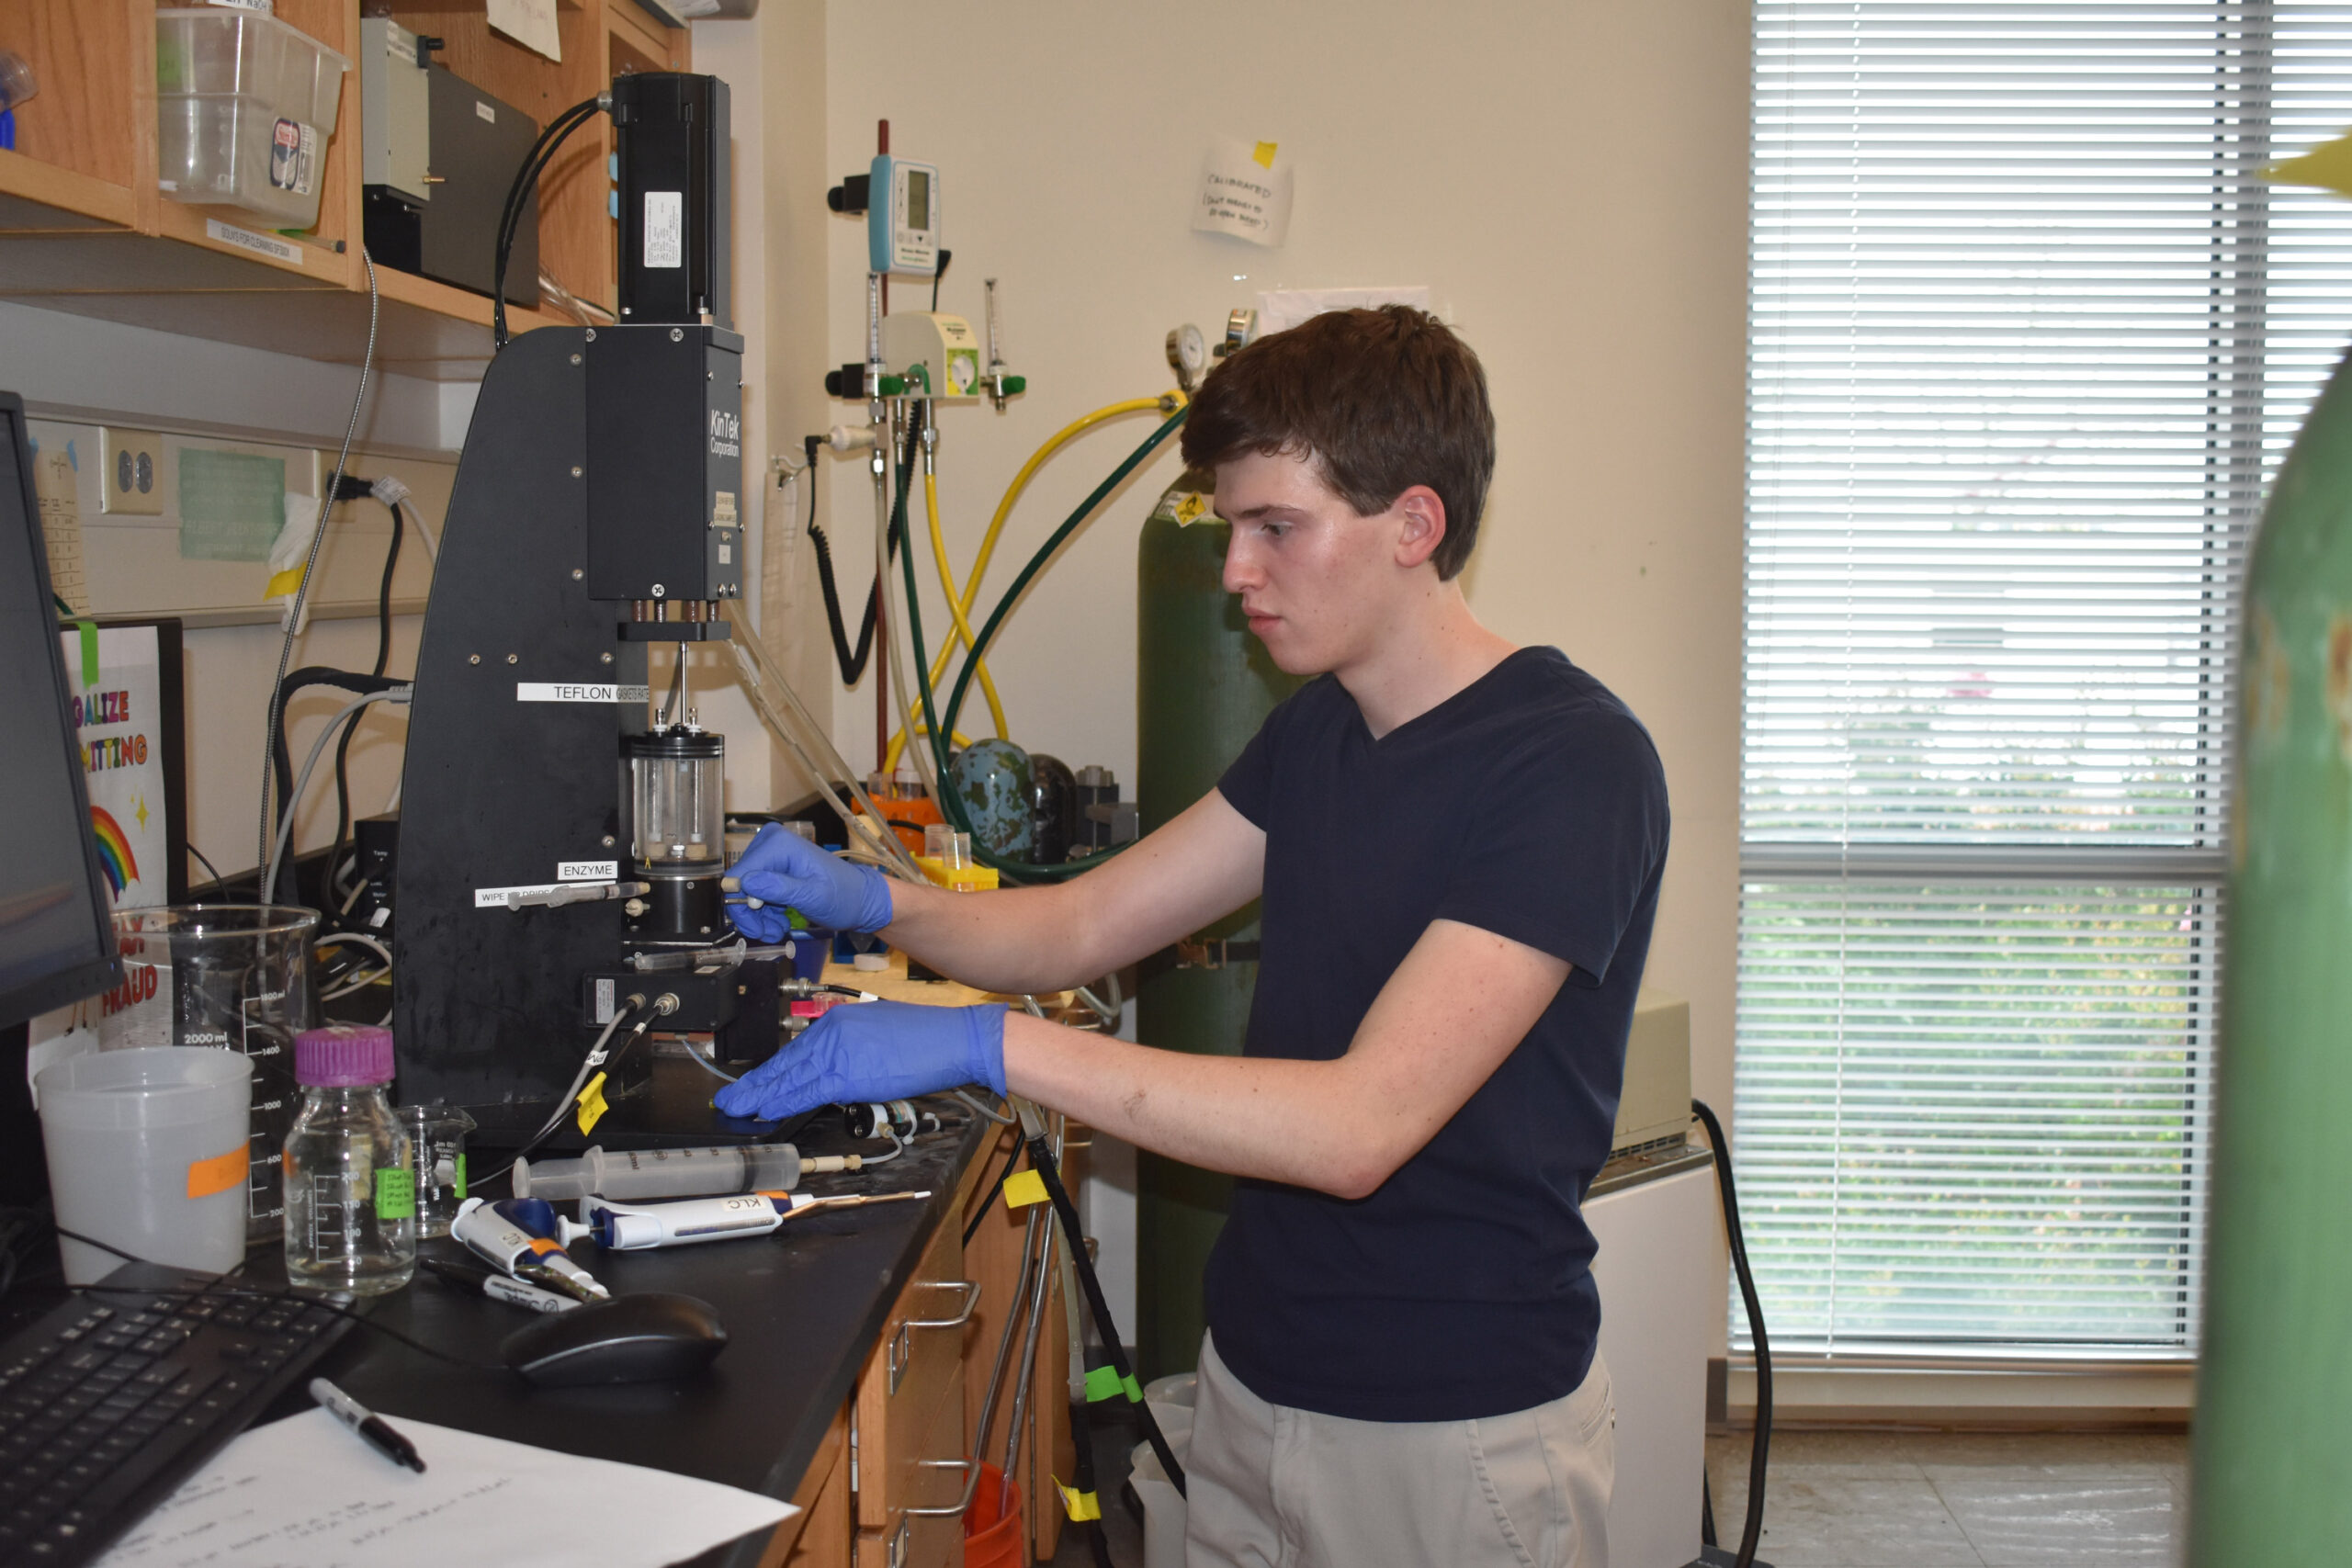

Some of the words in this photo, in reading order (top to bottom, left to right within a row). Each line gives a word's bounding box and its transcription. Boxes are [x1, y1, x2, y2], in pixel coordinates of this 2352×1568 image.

[710, 409, 740, 441] KinTek
[710, 436, 740, 457] Corporation
[554, 685, 612, 700] TEFLON
[73, 691, 129, 728] GALIZE
[79, 734, 147, 773] MITTING
[564, 864, 613, 876] ENZYME
[481, 892, 505, 902] WIPE
[185, 1033, 213, 1044] 2000
[215, 1032, 228, 1043] ml
[264, 1100, 281, 1111] 1000
[267, 1155, 282, 1164] 600
[728, 1198, 761, 1210] KLC
[269, 1208, 284, 1217] 200
